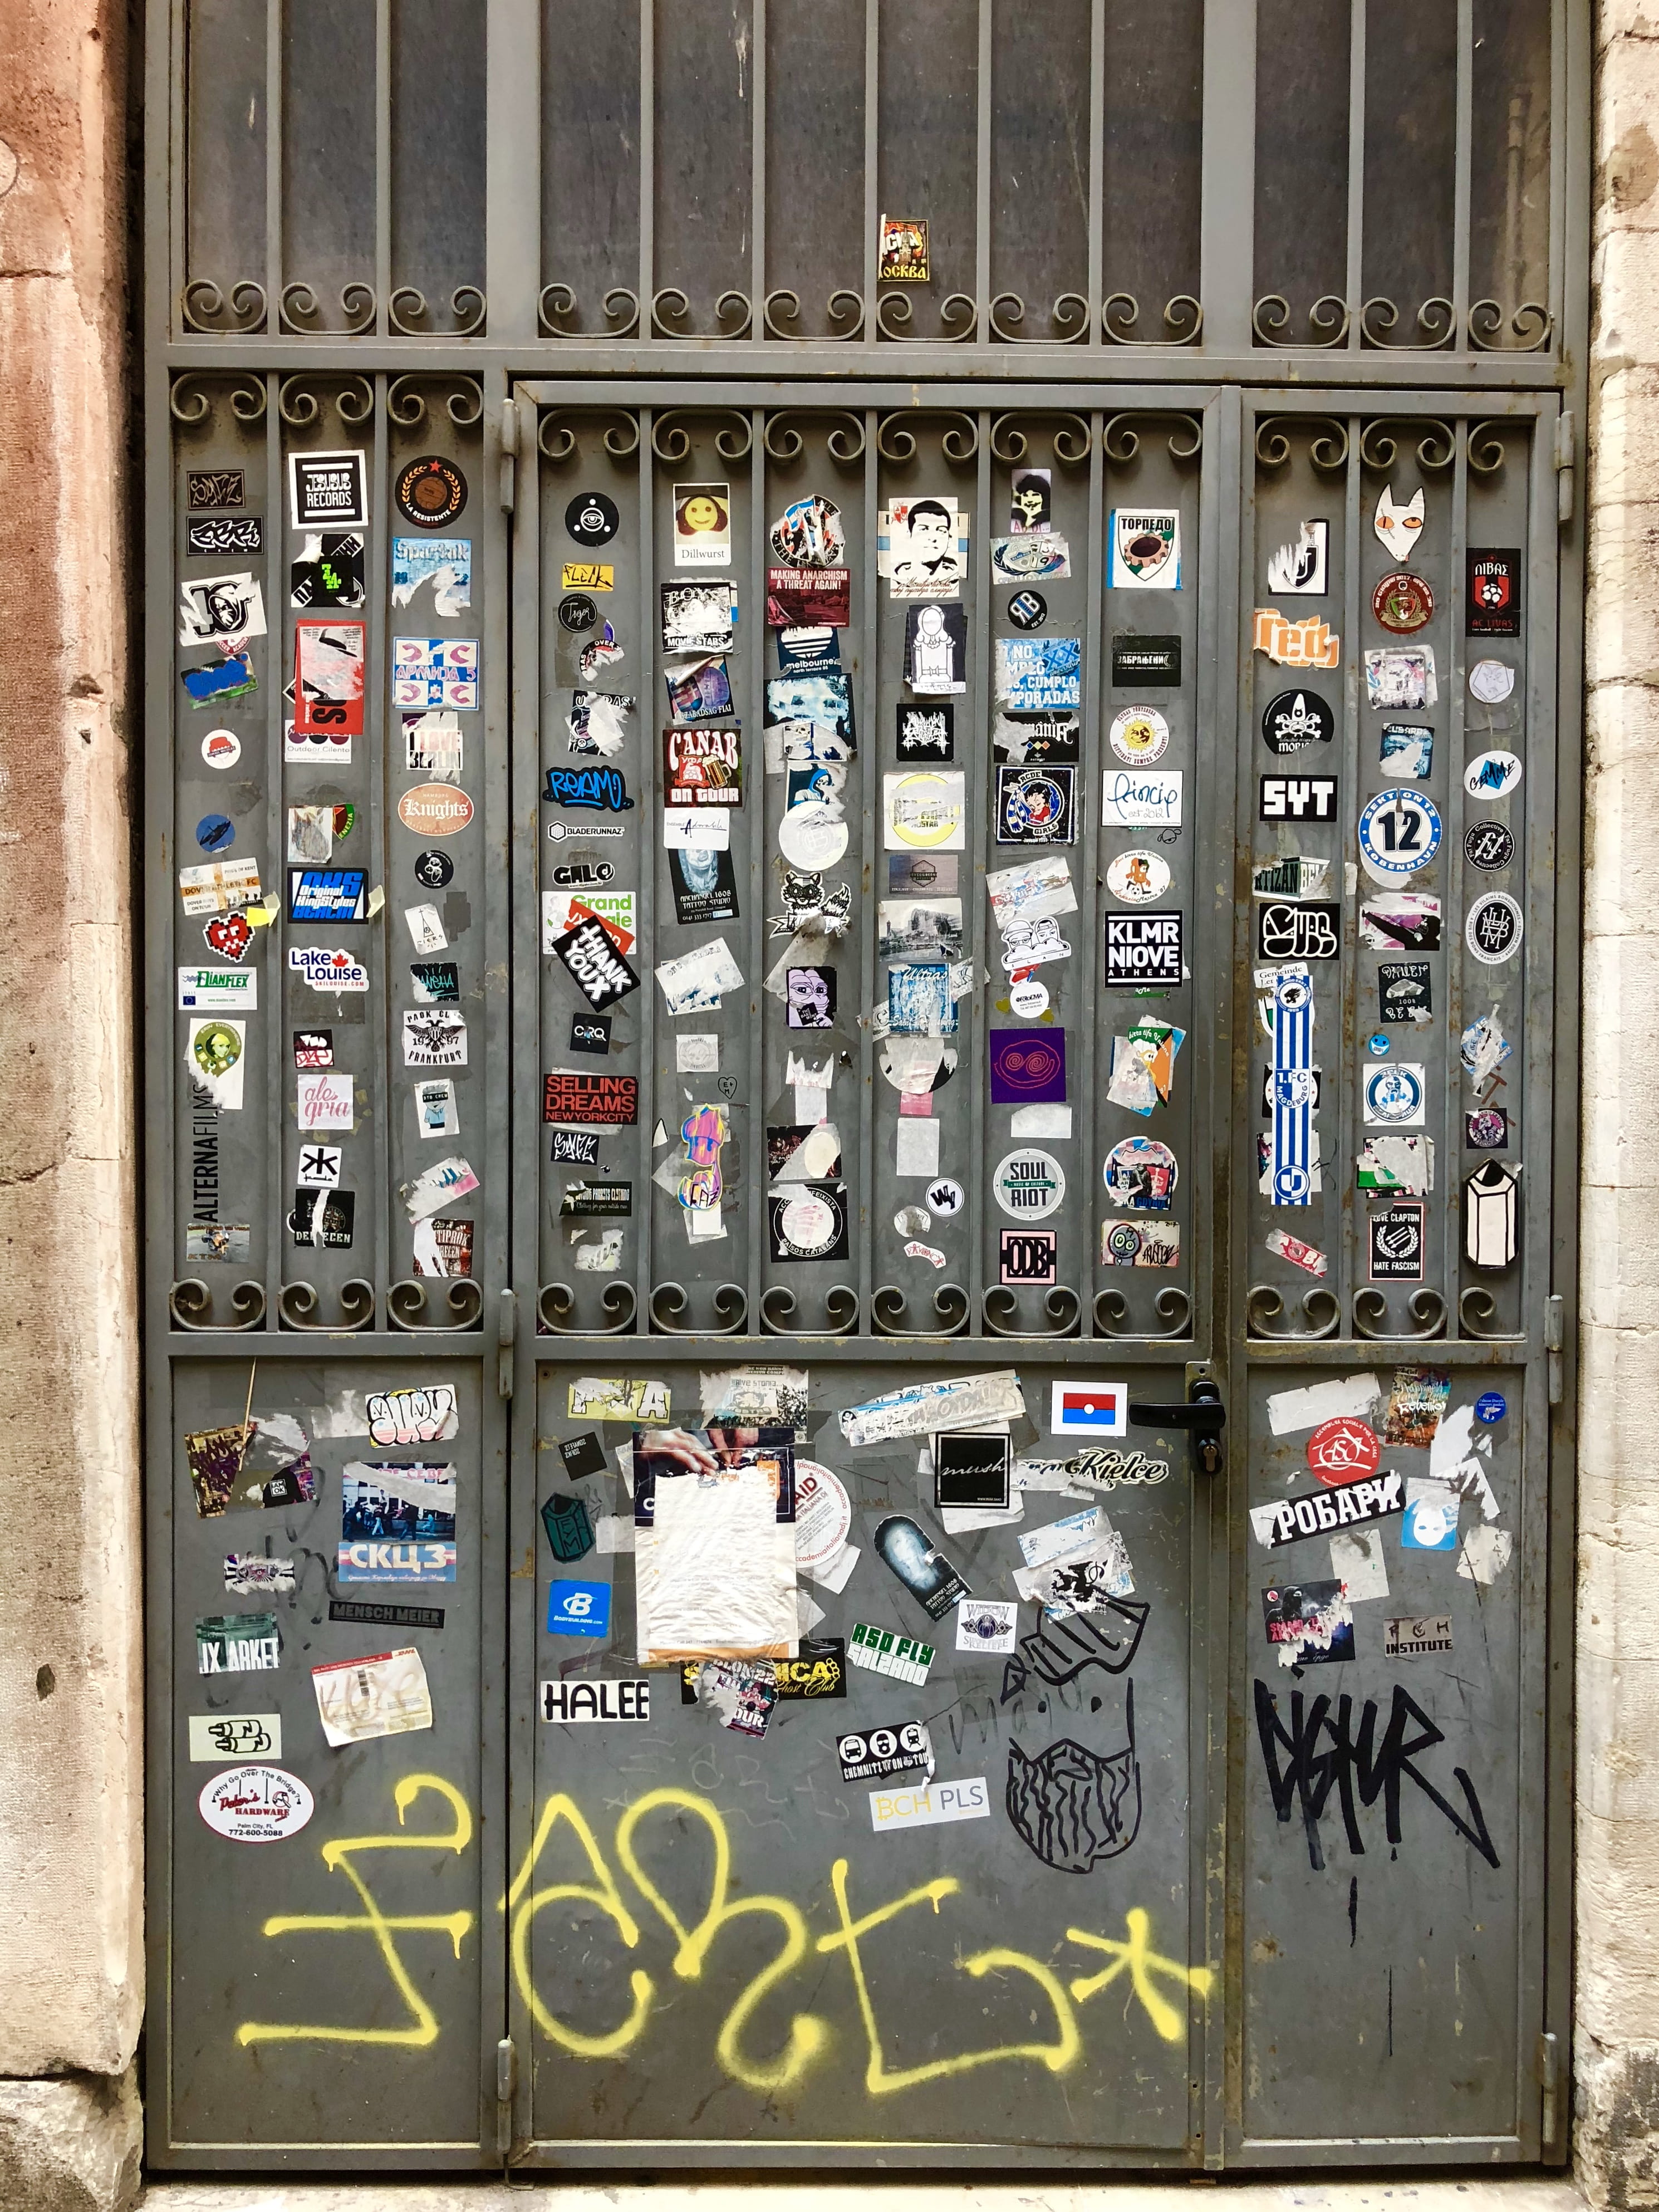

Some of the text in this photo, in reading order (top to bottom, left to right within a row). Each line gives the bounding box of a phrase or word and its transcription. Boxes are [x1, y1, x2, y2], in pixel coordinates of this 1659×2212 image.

[881, 265, 926, 279] ОСКВА
[307, 491, 352, 508] RECORDS
[405, 502, 414, 512] LA
[412, 509, 452, 523] RESISTENTE
[1121, 518, 1171, 532] ТОРПЕДО
[681, 549, 725, 558] Dillwurst
[770, 570, 848, 580] MAKING ANARCHISM
[776, 580, 842, 590] A THREAT AGAIN!
[696, 635, 725, 646] STARS
[1013, 645, 1032, 659] NO
[786, 658, 836, 669] melbourne
[1027, 676, 1077, 689] CUMPLO
[322, 745, 351, 754] Cilento
[1133, 755, 1154, 765] SEMPRE
[1019, 772, 1041, 783] RCDE
[671, 787, 739, 802] ON TOUR
[1264, 781, 1333, 816] SYT
[403, 798, 469, 820] Knights
[1423, 798, 1436, 817] 12
[338, 812, 354, 840] ENEZIA
[1034, 823, 1058, 835] GIRLS
[1376, 810, 1422, 852] 12
[1475, 823, 1504, 832] Collective
[1476, 860, 1504, 870] Collective
[299, 885, 343, 897] Original
[296, 896, 357, 910] KingStyles
[572, 895, 632, 910] Grand
[683, 897, 731, 909] TATTOO STUDIO
[1108, 923, 1179, 945] KLMR
[291, 951, 332, 966] Lake
[564, 938, 600, 983] YOU
[1108, 946, 1179, 968] NIOVE
[307, 966, 362, 980] Louise
[903, 967, 948, 981] Ultras
[1259, 966, 1303, 979] Gemeinde
[408, 1011, 431, 1023] PAOK
[409, 1049, 462, 1065] FRANKFURT
[547, 1076, 635, 1094] SELLING
[546, 1093, 635, 1112] DREAMS
[1276, 1085, 1308, 1107] MAGDEBURG
[1009, 1161, 1048, 1180] SOUL
[1010, 1188, 1049, 1207] RIOT
[1391, 1213, 1420, 1223] CLAPTON
[805, 1235, 837, 1256] CATALANS
[1373, 1261, 1420, 1271] HATE FASCISM
[1314, 1418, 1342, 1440] ASSEMBLEA
[1342, 1418, 1363, 1429] SOCIALE
[333, 1603, 440, 1624] MENSCH MEIER
[851, 1623, 895, 1652] ASD
[895, 1635, 935, 1665] FLY
[1386, 1639, 1452, 1655] INSTITUTE
[804, 1677, 835, 1696] Club
[892, 1757, 904, 1769] ON
[214, 1770, 302, 1799] Why Go Over The Bridge?
[940, 1785, 984, 1810] PLS
[234, 1807, 292, 1817] HARDWARE
